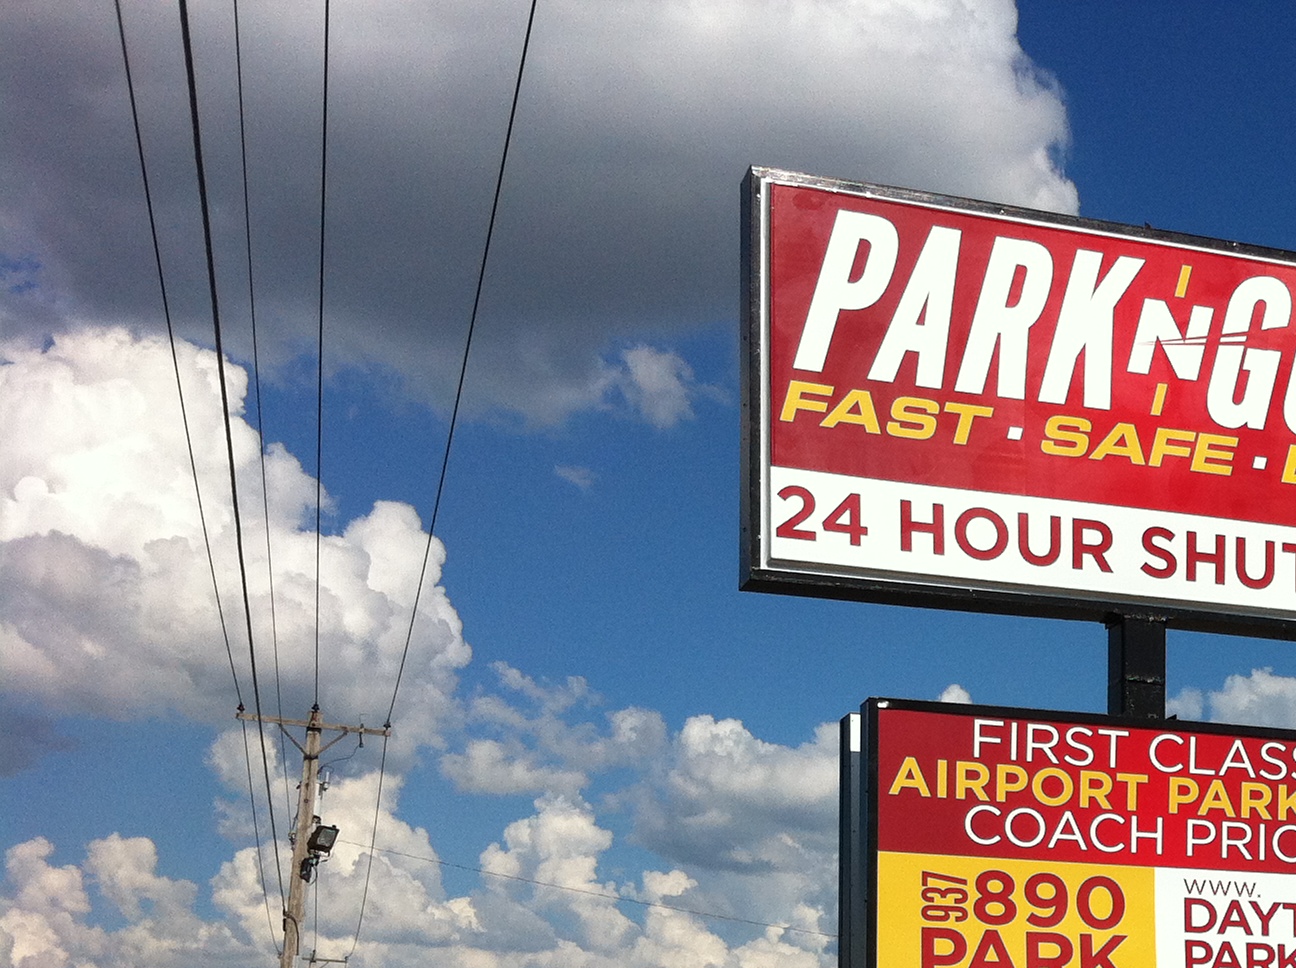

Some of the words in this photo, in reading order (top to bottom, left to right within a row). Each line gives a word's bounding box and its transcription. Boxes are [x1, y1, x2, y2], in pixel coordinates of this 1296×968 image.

[792, 208, 1145, 411] PARK
[1127, 298, 1213, 382] N
[779, 380, 995, 445] FAST
[1040, 415, 1238, 477] SAFE
[776, 485, 868, 547] 24
[900, 499, 1114, 574] HOUR
[972, 718, 1130, 768] FIRST
[888, 756, 1148, 811] AIRPORT
[964, 804, 1164, 854] COACH
[921, 871, 969, 922] 937
[973, 869, 1126, 929] 890
